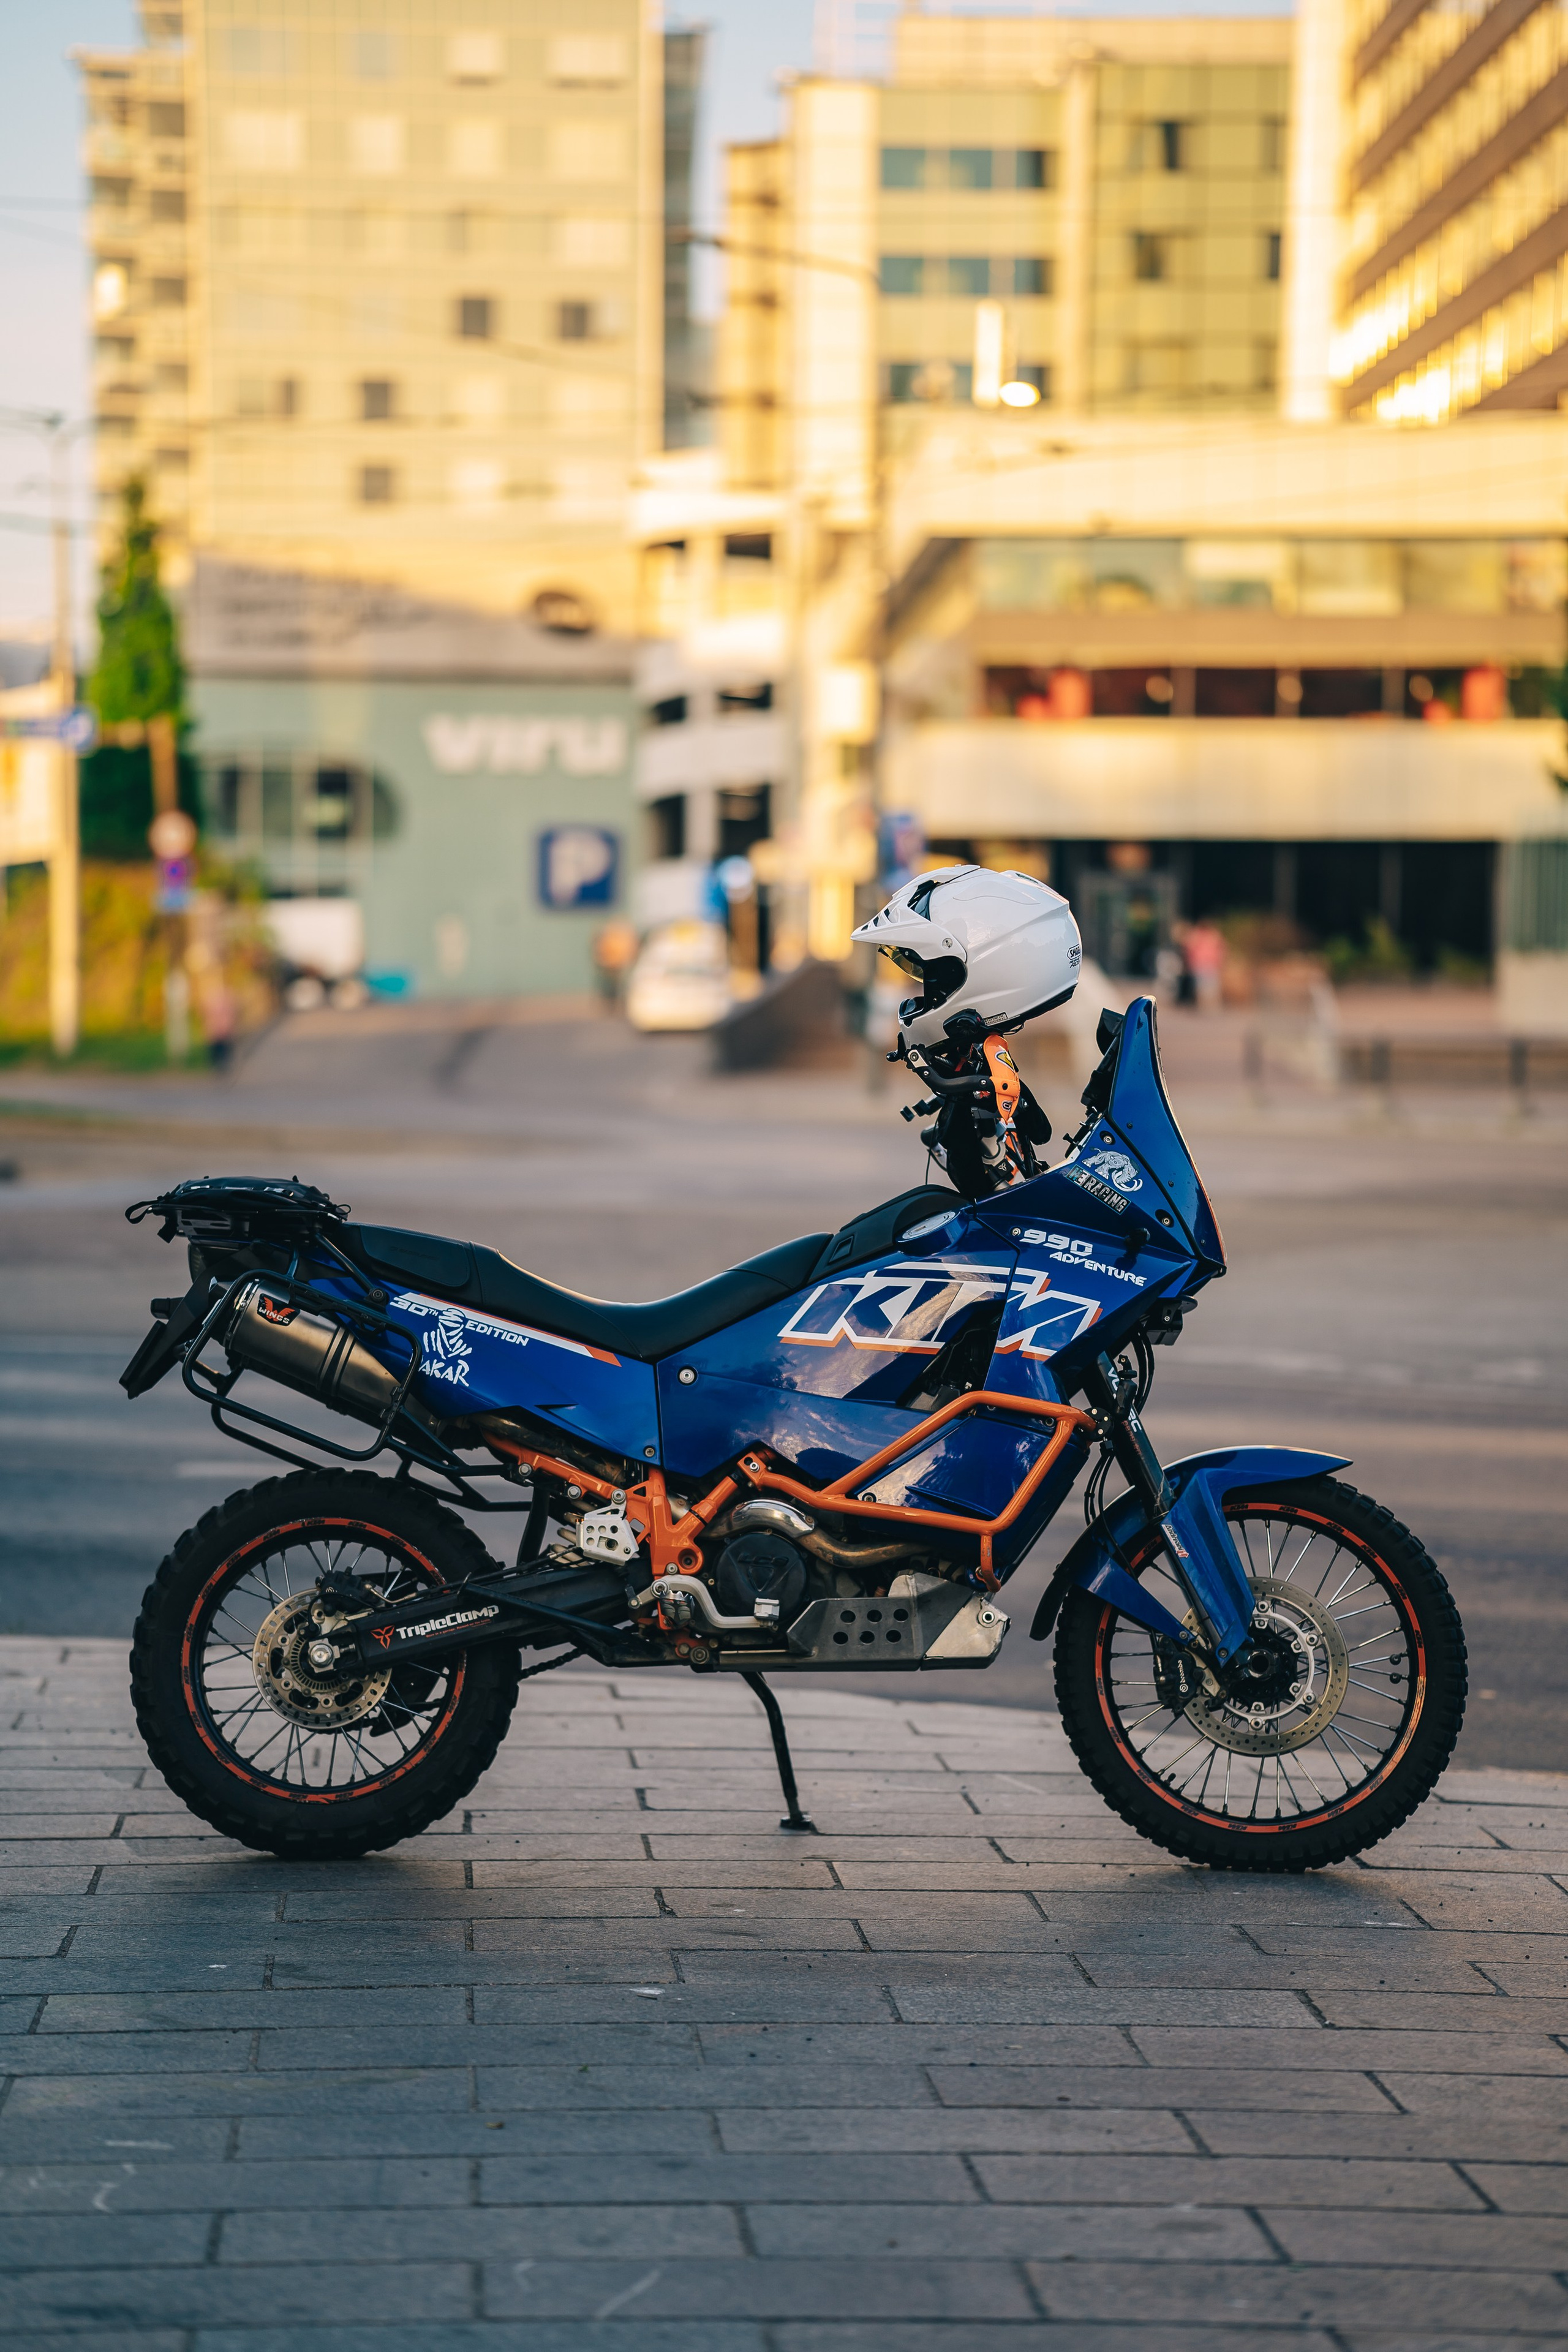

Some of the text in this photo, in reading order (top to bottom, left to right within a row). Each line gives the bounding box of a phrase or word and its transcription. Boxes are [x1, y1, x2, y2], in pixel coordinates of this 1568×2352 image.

[549, 831, 611, 905] P
[1084, 1177, 1128, 1212] RACING
[1019, 1229, 1093, 1257] 990
[1049, 1251, 1147, 1287] ADVENTURE
[258, 1306, 290, 1324] WINGS
[777, 1262, 1102, 1361] KTM
[465, 1320, 529, 1346] EDITION
[414, 1357, 470, 1387] AKAR
[1278, 1506, 1298, 1514] KTM
[1166, 1525, 1183, 1551] Andreani
[1325, 1521, 1345, 1534] KTM
[1360, 1544, 1378, 1559] KTM
[1394, 1582, 1408, 1600] KTM
[1177, 1659, 1186, 1683] brembo
[1136, 1769, 1152, 1784] KTM
[1181, 1805, 1199, 1816] KTM
[1327, 1806, 1344, 1818] KTM
